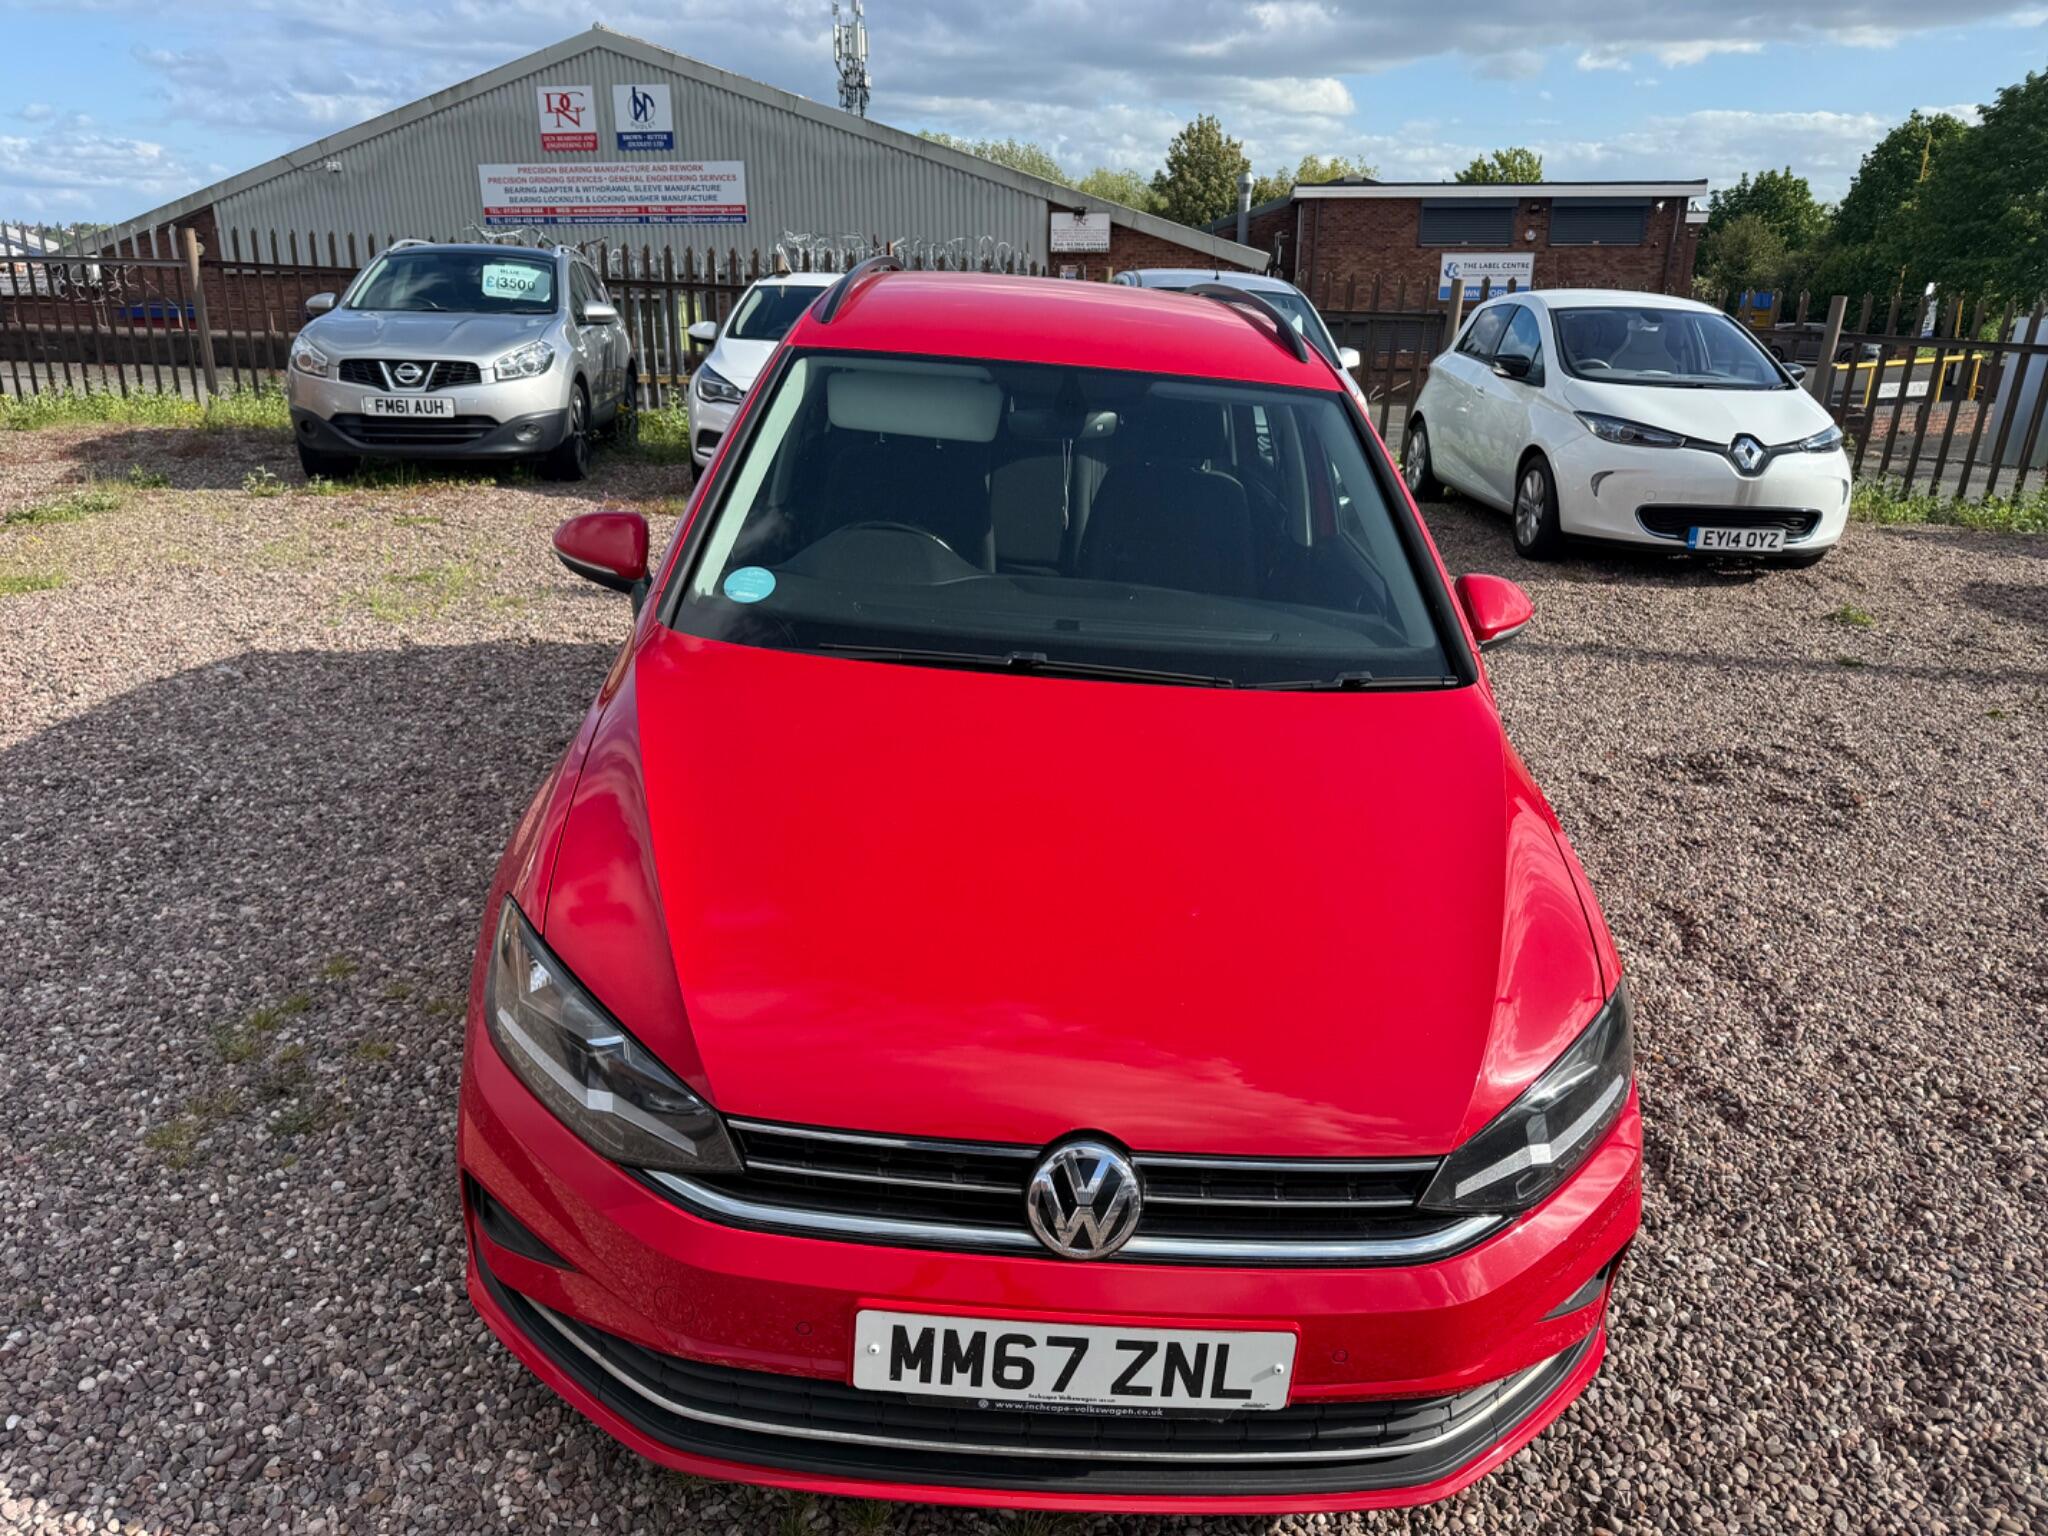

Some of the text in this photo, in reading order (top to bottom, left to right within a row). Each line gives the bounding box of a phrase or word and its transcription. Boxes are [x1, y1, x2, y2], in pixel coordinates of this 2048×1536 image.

[517, 164, 703, 174] PRECISION BEARING MANUFACTURE AND REWORK
[487, 174, 737, 185] PRECISION GRINDING SERVICES GENERAL ENGINEERING SERVICES
[504, 186, 537, 194] BEARING
[539, 186, 573, 194] ADAPTER
[582, 185, 632, 193] WITHDRAWAL
[664, 184, 721, 192] MANUFACTURE
[509, 194, 718, 204] BEARING LOCKNUTS & LOCKING WASHER MANUFACTURE
[375, 399, 444, 414] FM61 AUH
[1703, 530, 1779, 548] EY14 OYZ
[889, 1324, 1252, 1399] MM67 ZNL
[994, 1401, 1164, 1416] www.inchcape-volkswagen.co.uk
